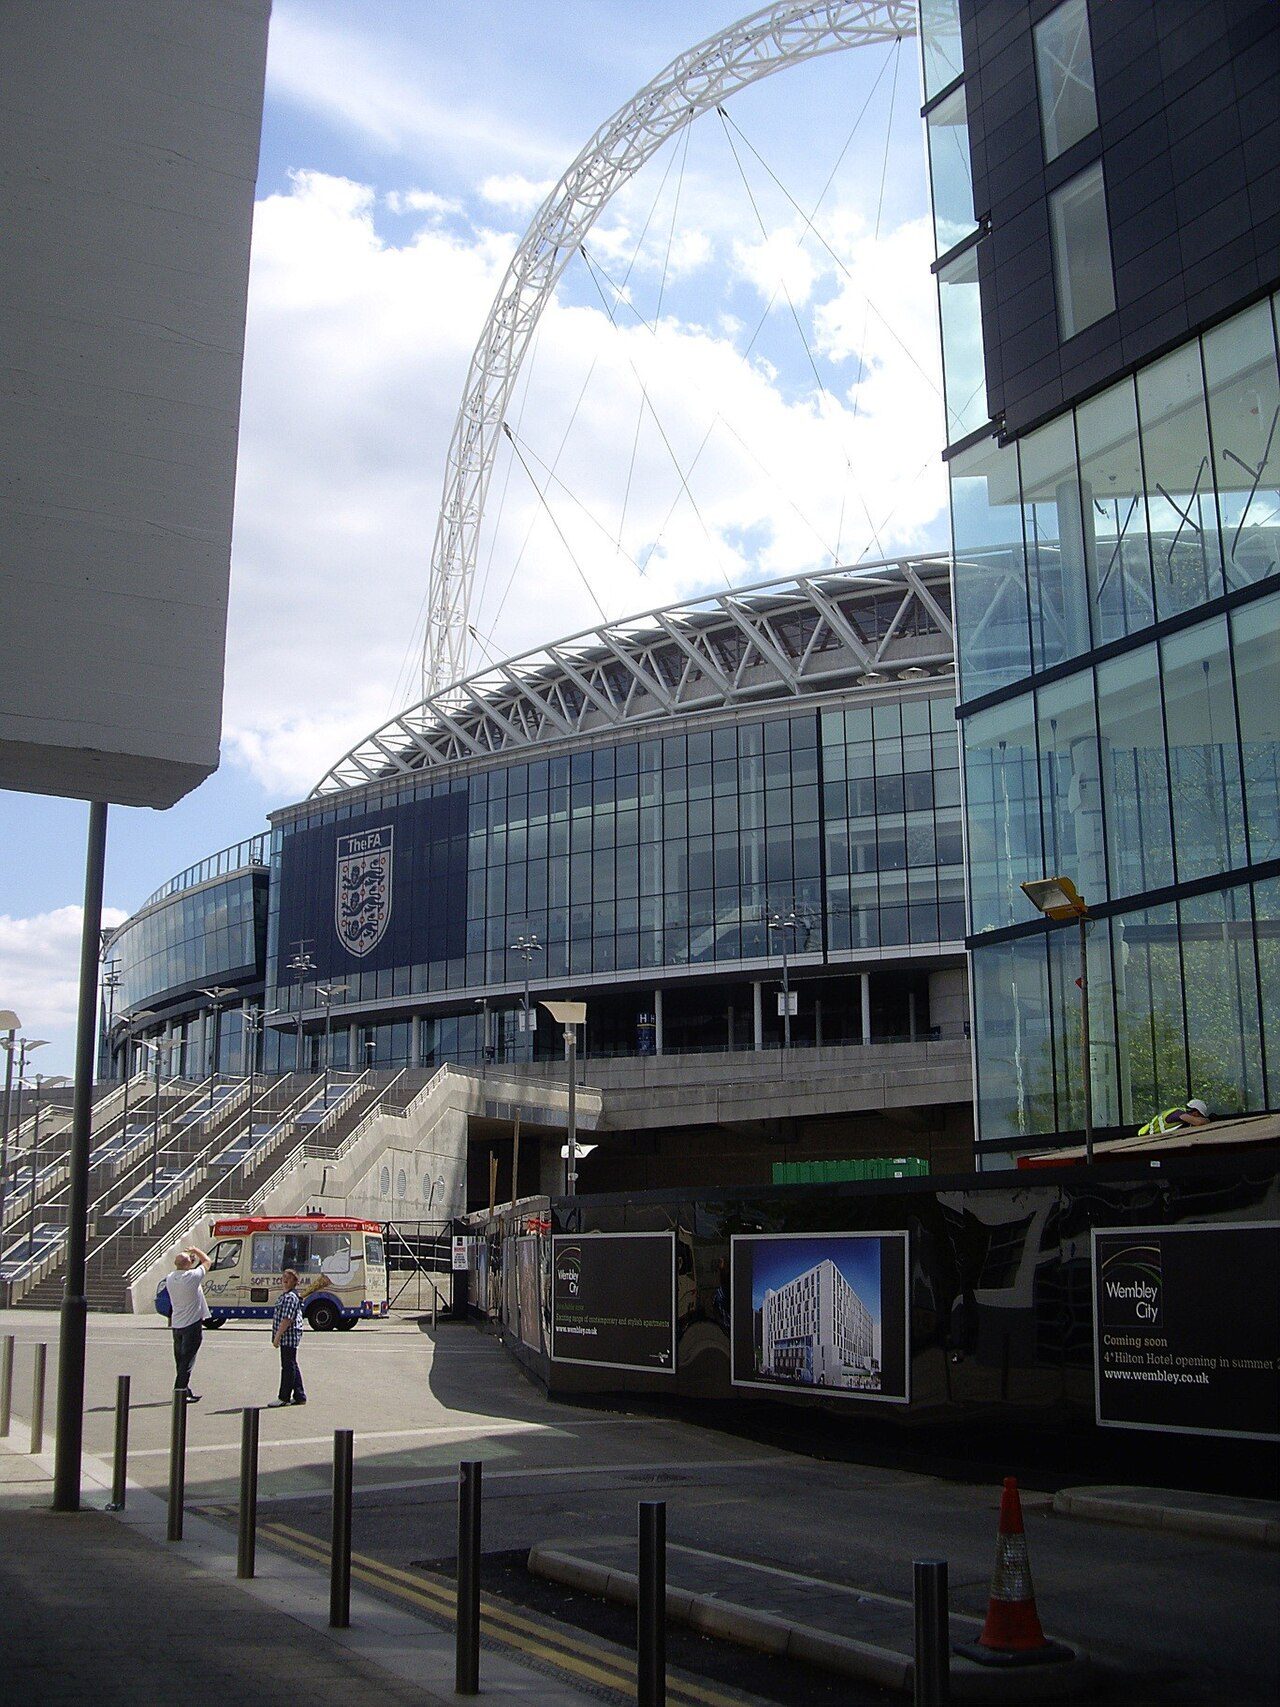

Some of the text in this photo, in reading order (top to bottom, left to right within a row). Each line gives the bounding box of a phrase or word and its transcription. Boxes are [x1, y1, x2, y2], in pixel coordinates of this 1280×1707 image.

[250, 1277, 283, 1286] SOFT IC
[558, 1268, 579, 1283] Wembley
[569, 1281, 579, 1296] City
[1106, 1281, 1158, 1303] Wembley
[1136, 1302, 1158, 1323] City
[589, 1316, 617, 1326] contemporary
[618, 1317, 627, 1325] and
[627, 1317, 642, 1327] stylish
[643, 1319, 670, 1328] apartments
[555, 1325, 598, 1336] www.wembley.co.uk
[1103, 1334, 1168, 1349] Coming soon
[1115, 1351, 1144, 1364] Hilton
[1146, 1352, 1173, 1365] Hotel
[1175, 1355, 1217, 1370] opening
[1219, 1355, 1230, 1368] in
[1232, 1358, 1274, 1370] summer
[1104, 1370, 1210, 1385] www.wembley.co.uk
